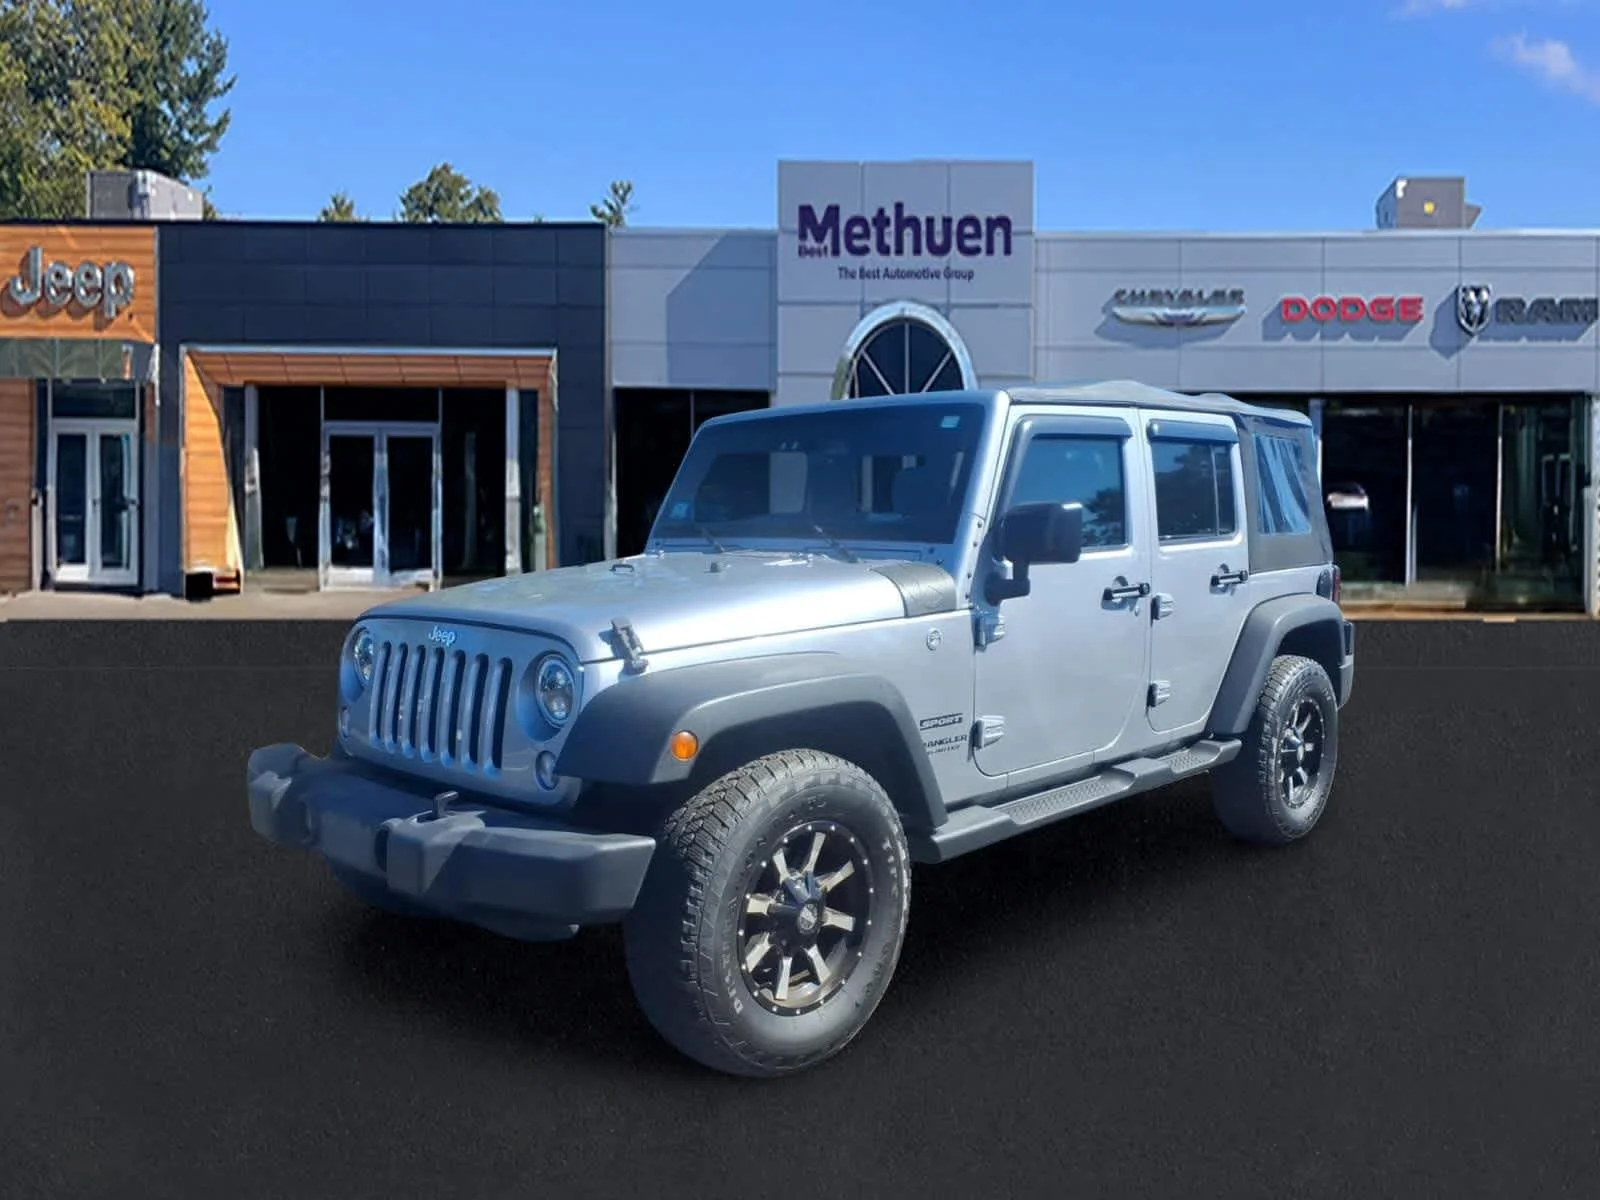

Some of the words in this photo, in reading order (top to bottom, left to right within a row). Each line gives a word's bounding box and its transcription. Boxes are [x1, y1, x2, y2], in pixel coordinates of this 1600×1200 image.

[798, 201, 1012, 257] Methuen
[9, 246, 134, 319] Jeep
[838, 266, 857, 280] The
[859, 266, 880, 280] Best
[883, 266, 941, 280] Automotive
[943, 266, 974, 282] Group
[1281, 297, 1424, 322] DODGE
[1495, 298, 1598, 323] RAM
[428, 624, 456, 647] Jeep
[923, 735, 968, 748] ANGLER
